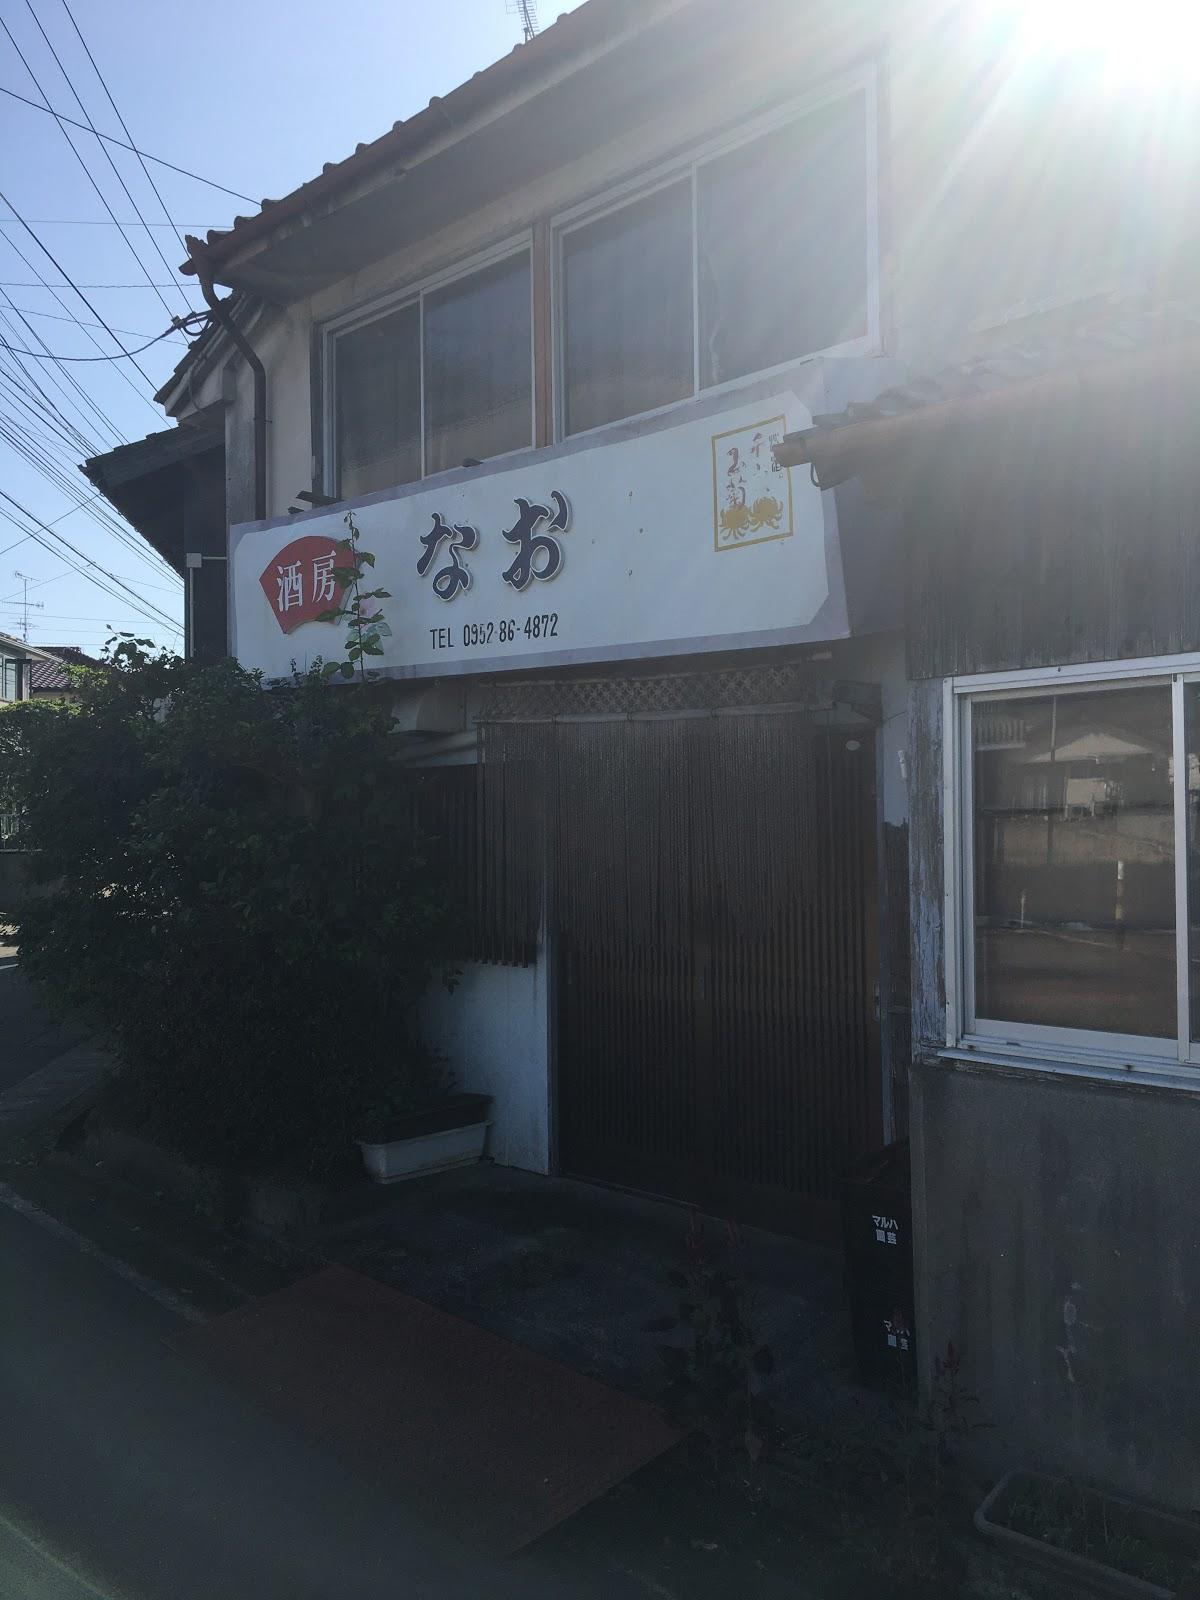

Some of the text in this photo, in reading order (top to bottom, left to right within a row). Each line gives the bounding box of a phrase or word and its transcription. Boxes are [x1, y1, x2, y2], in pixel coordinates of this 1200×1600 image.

[416, 490, 571, 602] なお
[276, 549, 337, 612] 酒房
[429, 627, 454, 649] TEL
[872, 1214, 898, 1230] マルハ
